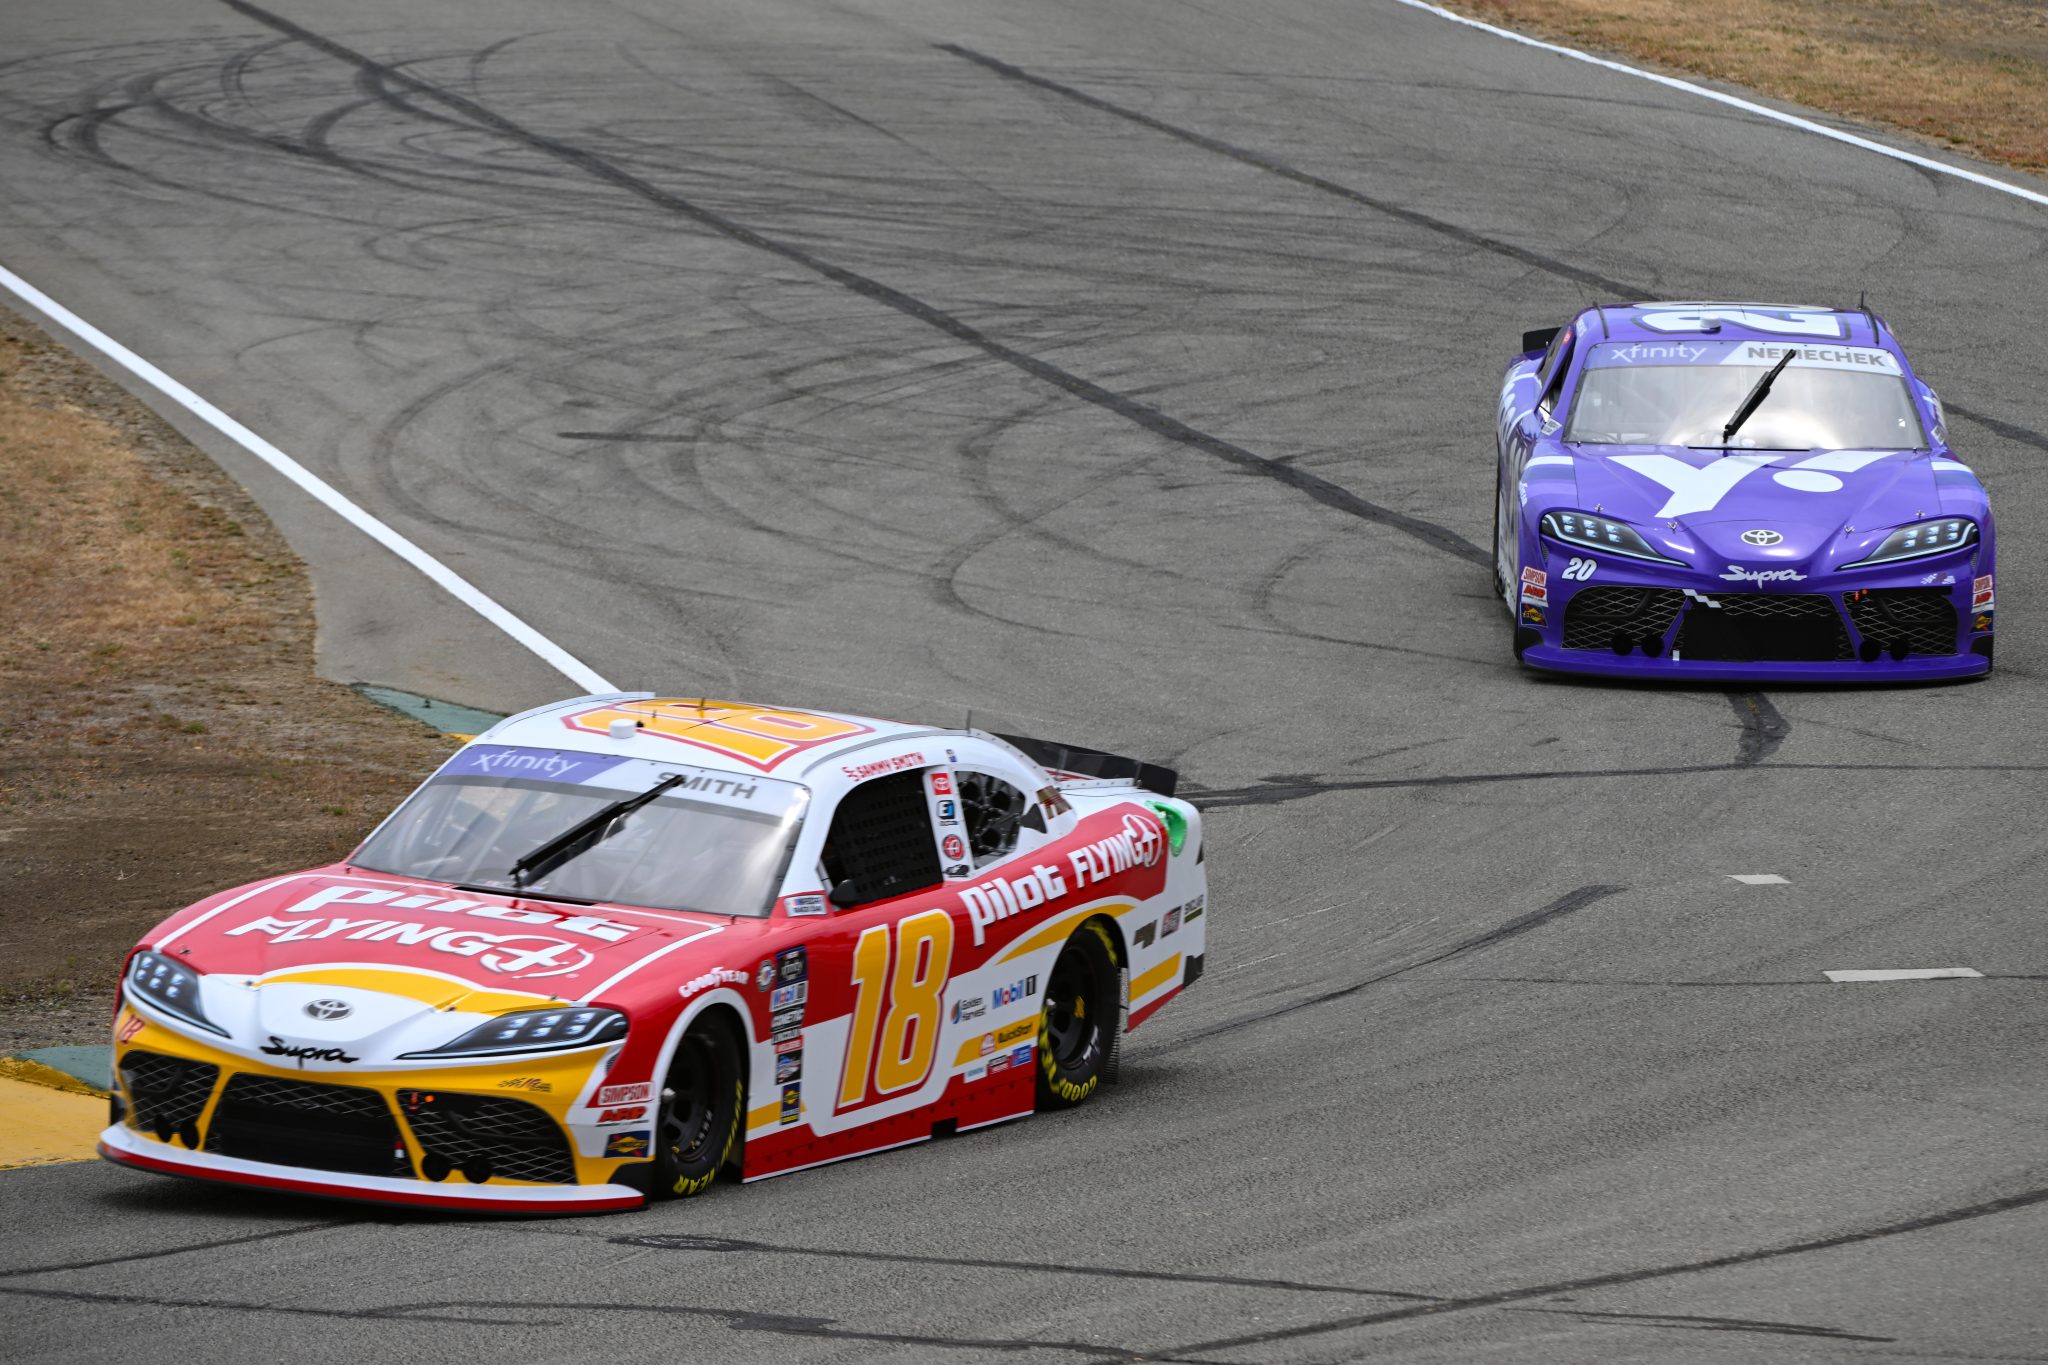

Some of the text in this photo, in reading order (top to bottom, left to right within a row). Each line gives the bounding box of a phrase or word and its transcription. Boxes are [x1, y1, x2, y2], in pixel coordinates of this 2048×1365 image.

[1611, 344, 1706, 362] xfinity
[1747, 346, 1886, 367] NEMECHEK
[1524, 567, 1546, 586] SIMPSON
[1561, 556, 1598, 582] 20
[1718, 565, 1808, 589] Supra
[470, 749, 582, 778] xfinity
[653, 771, 757, 800] SMITH
[1067, 825, 1143, 890] FLYING
[224, 915, 497, 957] FLYING
[992, 978, 1024, 1009] Mobil
[837, 908, 955, 1110] 18
[259, 1035, 360, 1070] Supra
[602, 1084, 650, 1103] SIMPSON
